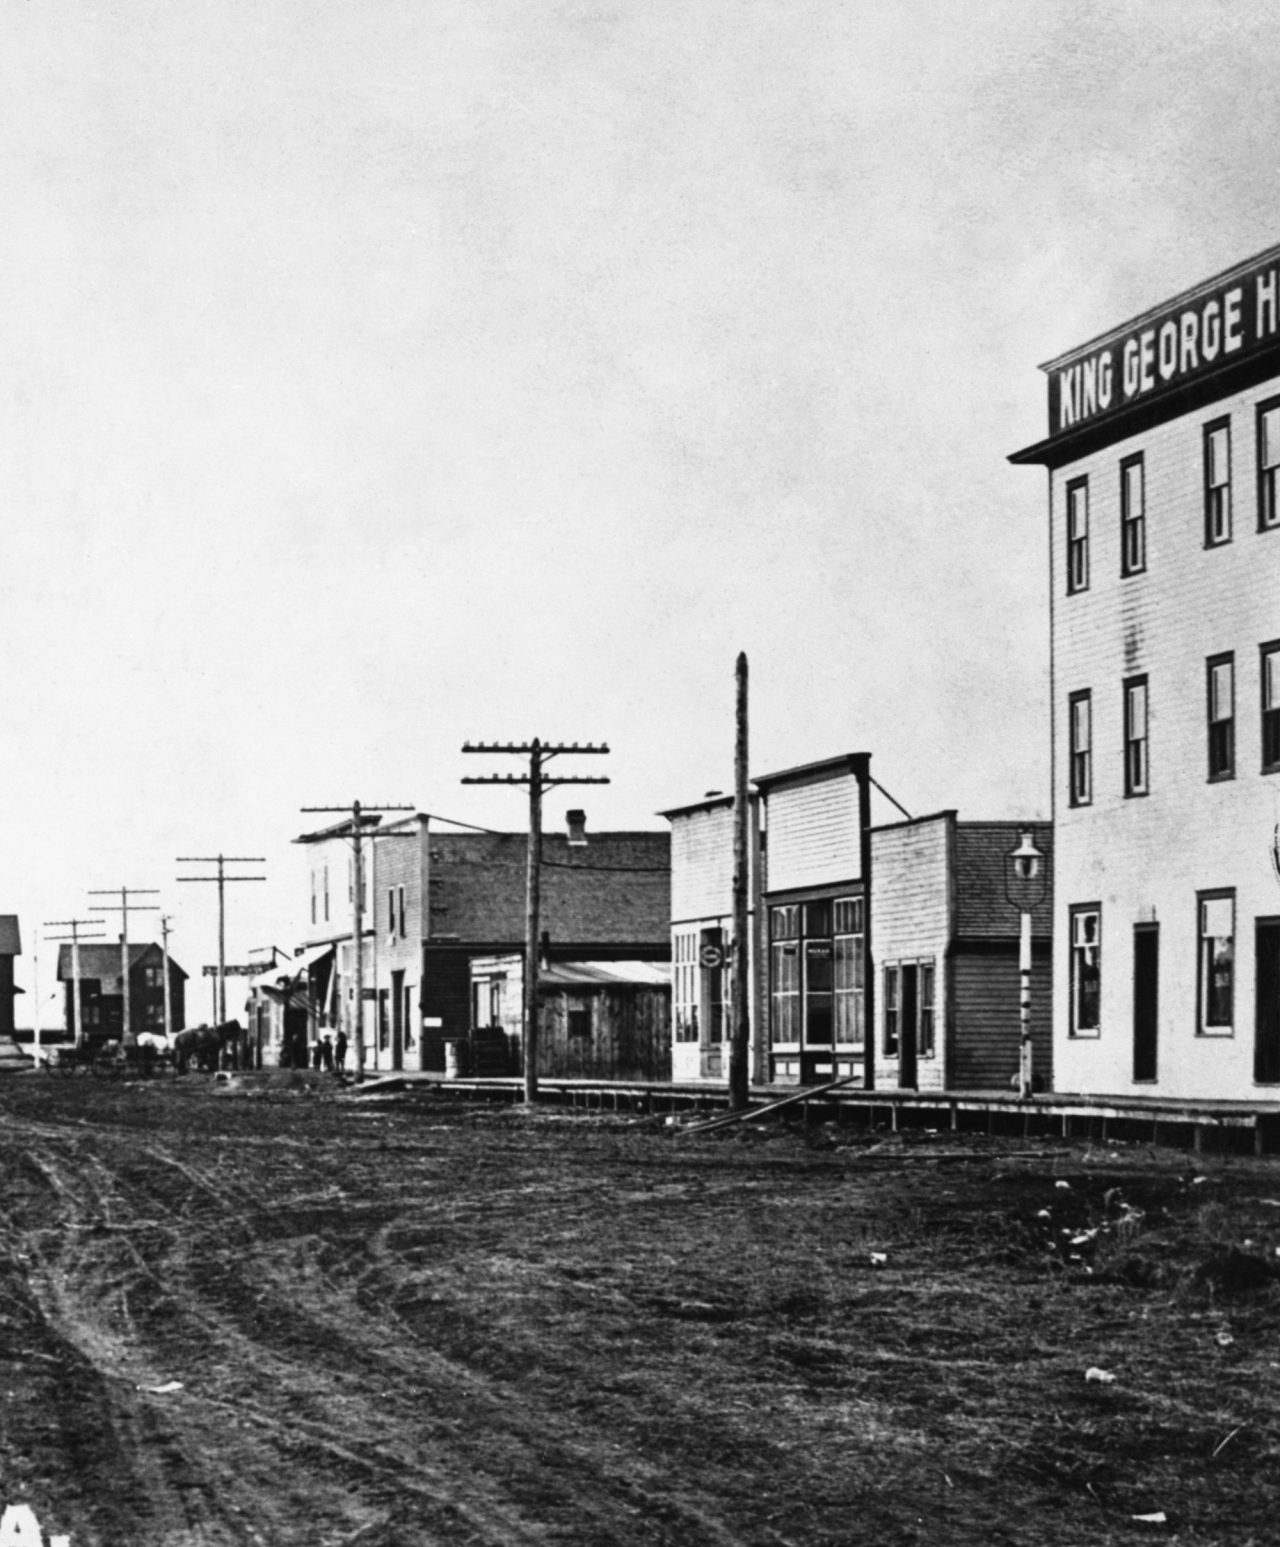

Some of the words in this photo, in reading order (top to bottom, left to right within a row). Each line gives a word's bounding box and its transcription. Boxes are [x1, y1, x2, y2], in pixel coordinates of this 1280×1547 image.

[1059, 350, 1114, 430] KING
[1122, 286, 1244, 398] GEORGE
[1256, 268, 1280, 340] H
